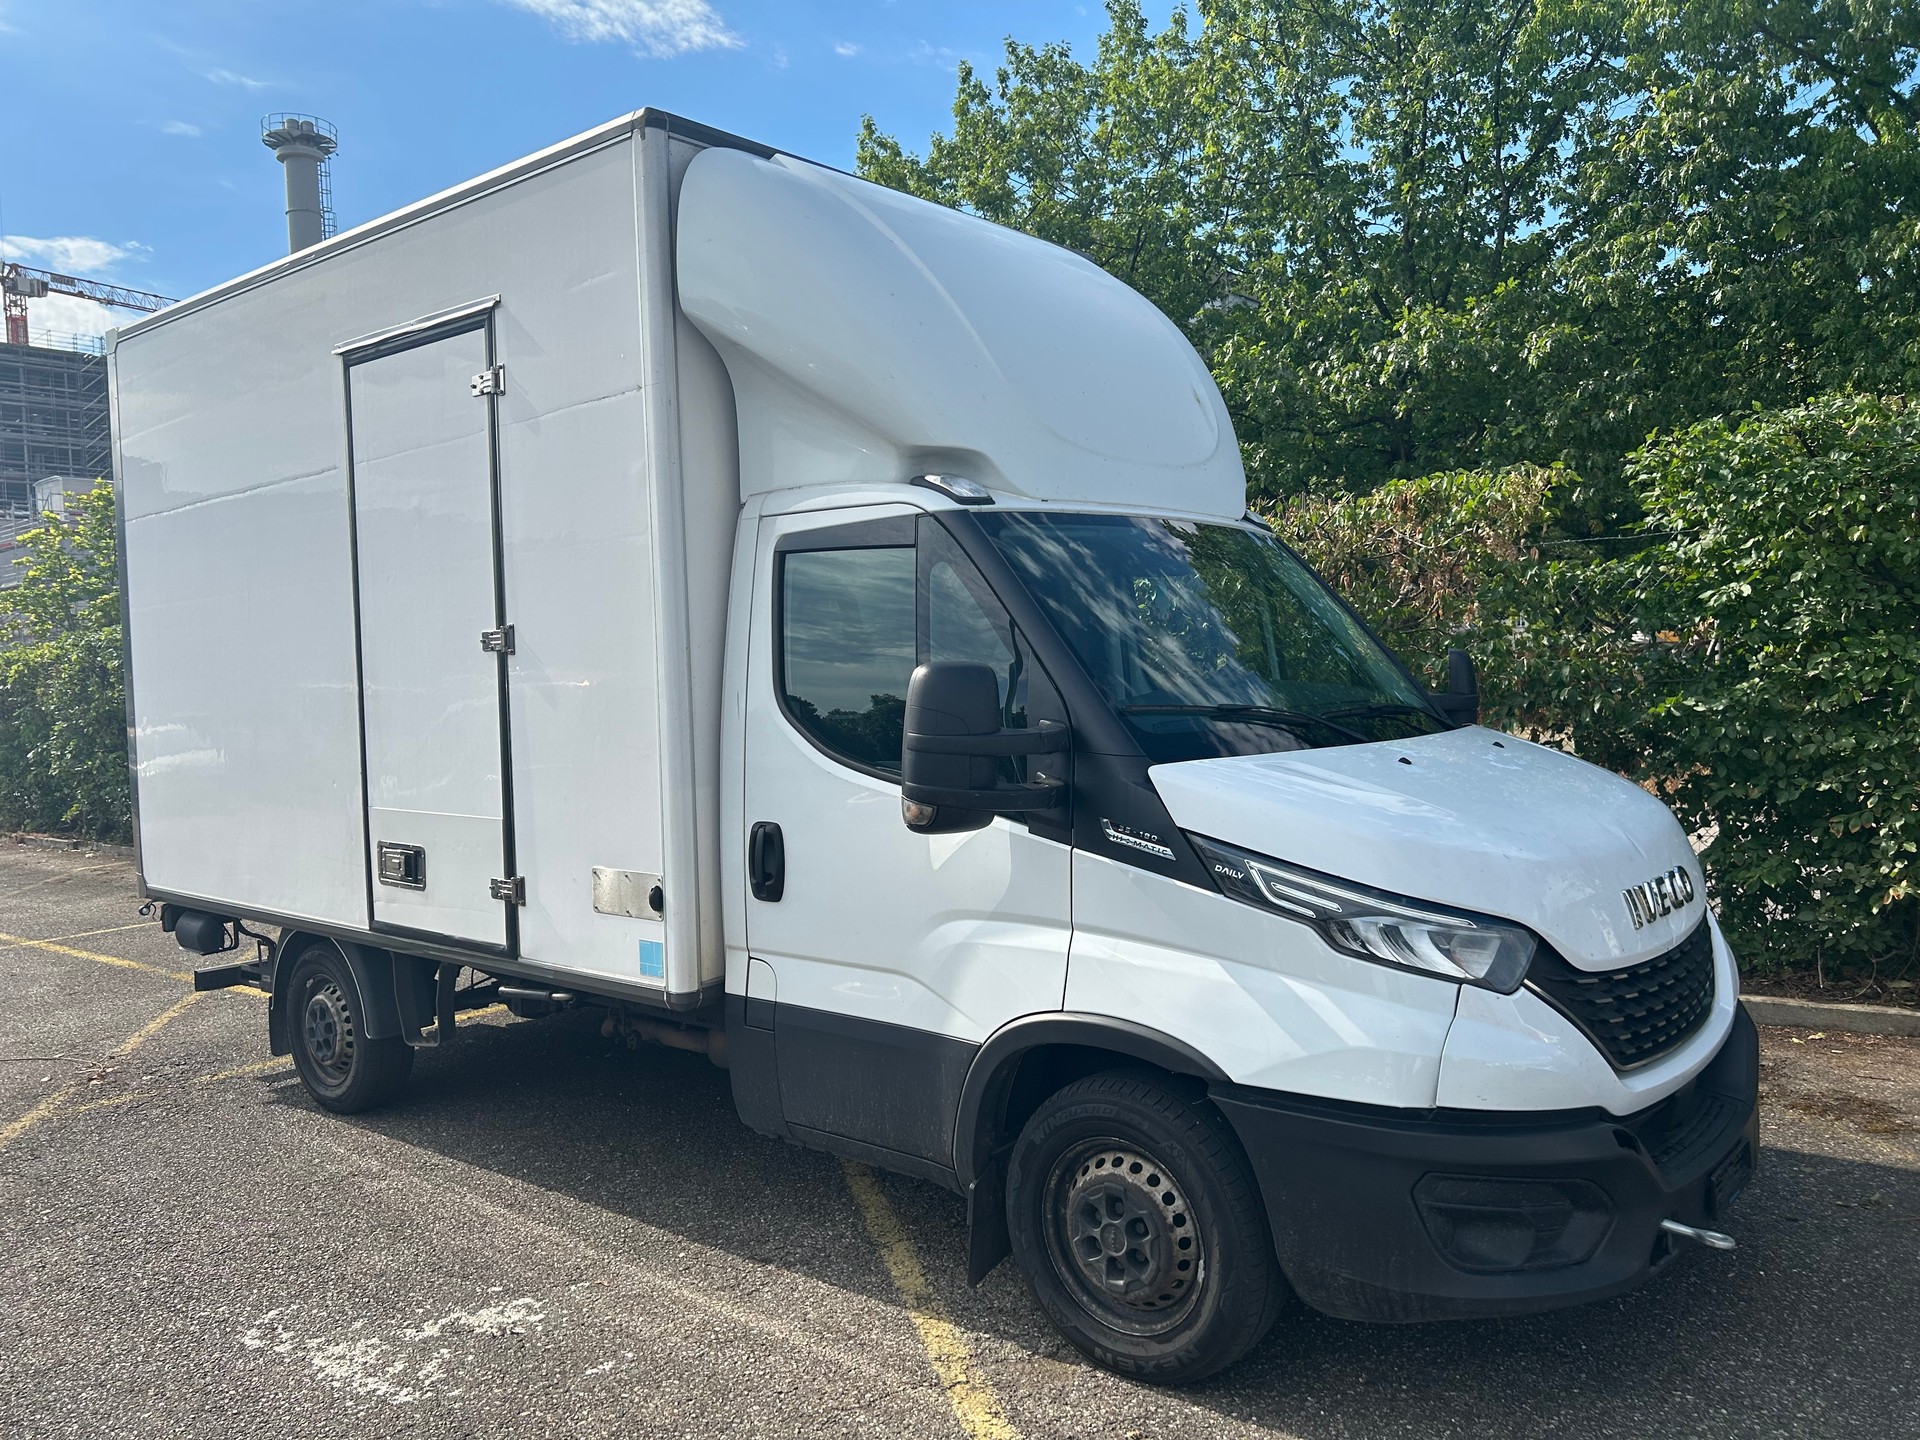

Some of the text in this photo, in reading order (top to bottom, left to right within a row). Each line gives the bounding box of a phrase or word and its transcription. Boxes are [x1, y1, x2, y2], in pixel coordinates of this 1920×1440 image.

[1214, 864, 1245, 880] DAILY
[1621, 865, 1694, 931] IVECO
[1094, 1345, 1201, 1374] NEXEN
